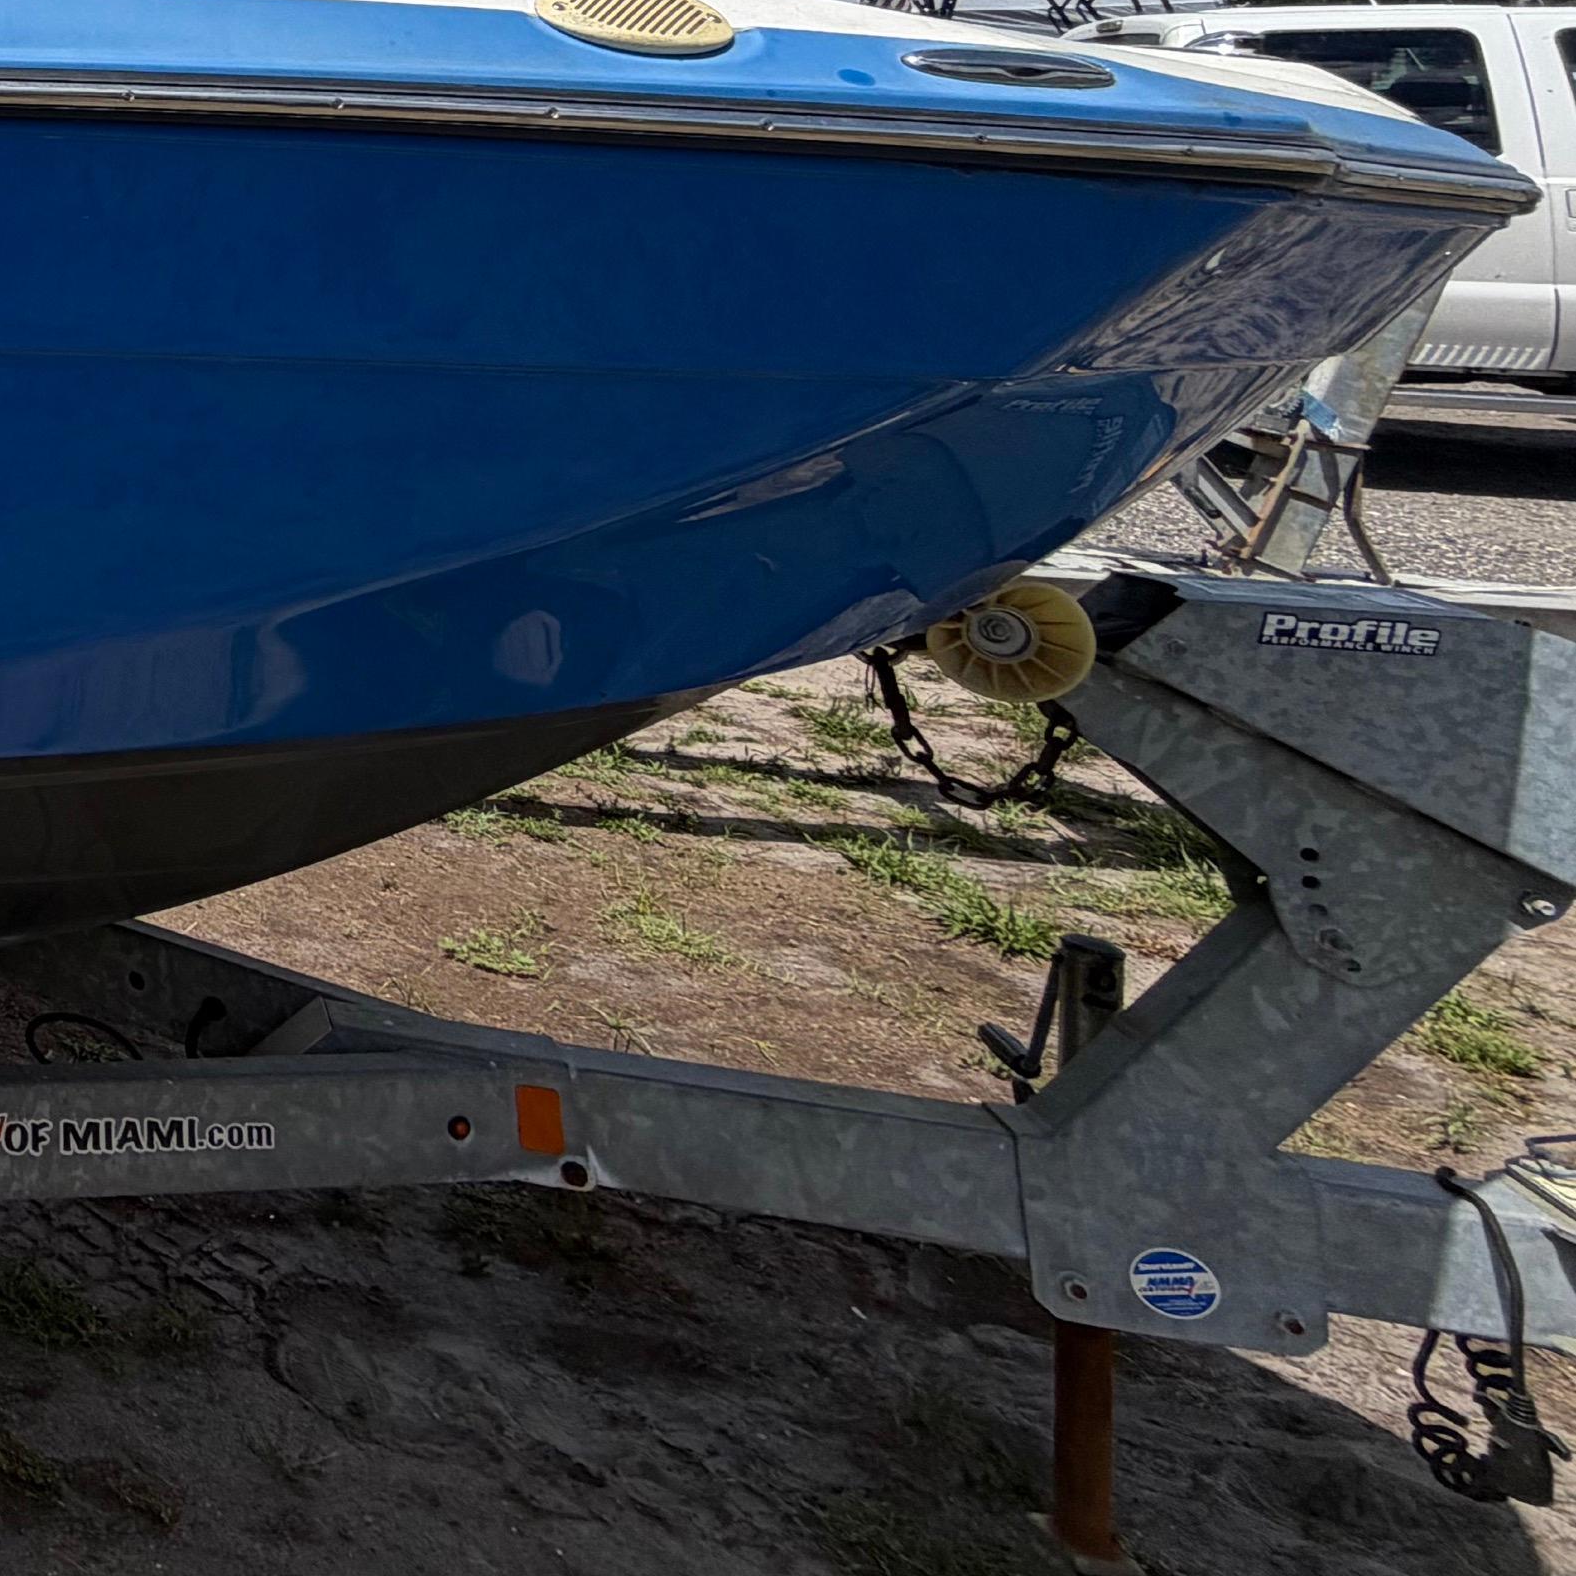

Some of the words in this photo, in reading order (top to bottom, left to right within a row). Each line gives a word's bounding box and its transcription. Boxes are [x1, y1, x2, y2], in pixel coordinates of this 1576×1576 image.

[1261, 635, 1375, 652] PERFORMANCE
[1380, 644, 1435, 655] WINCH
[1262, 613, 1441, 648] Profile
[4, 1120, 51, 1155] OF
[60, 1117, 275, 1154] MIAMI.com
